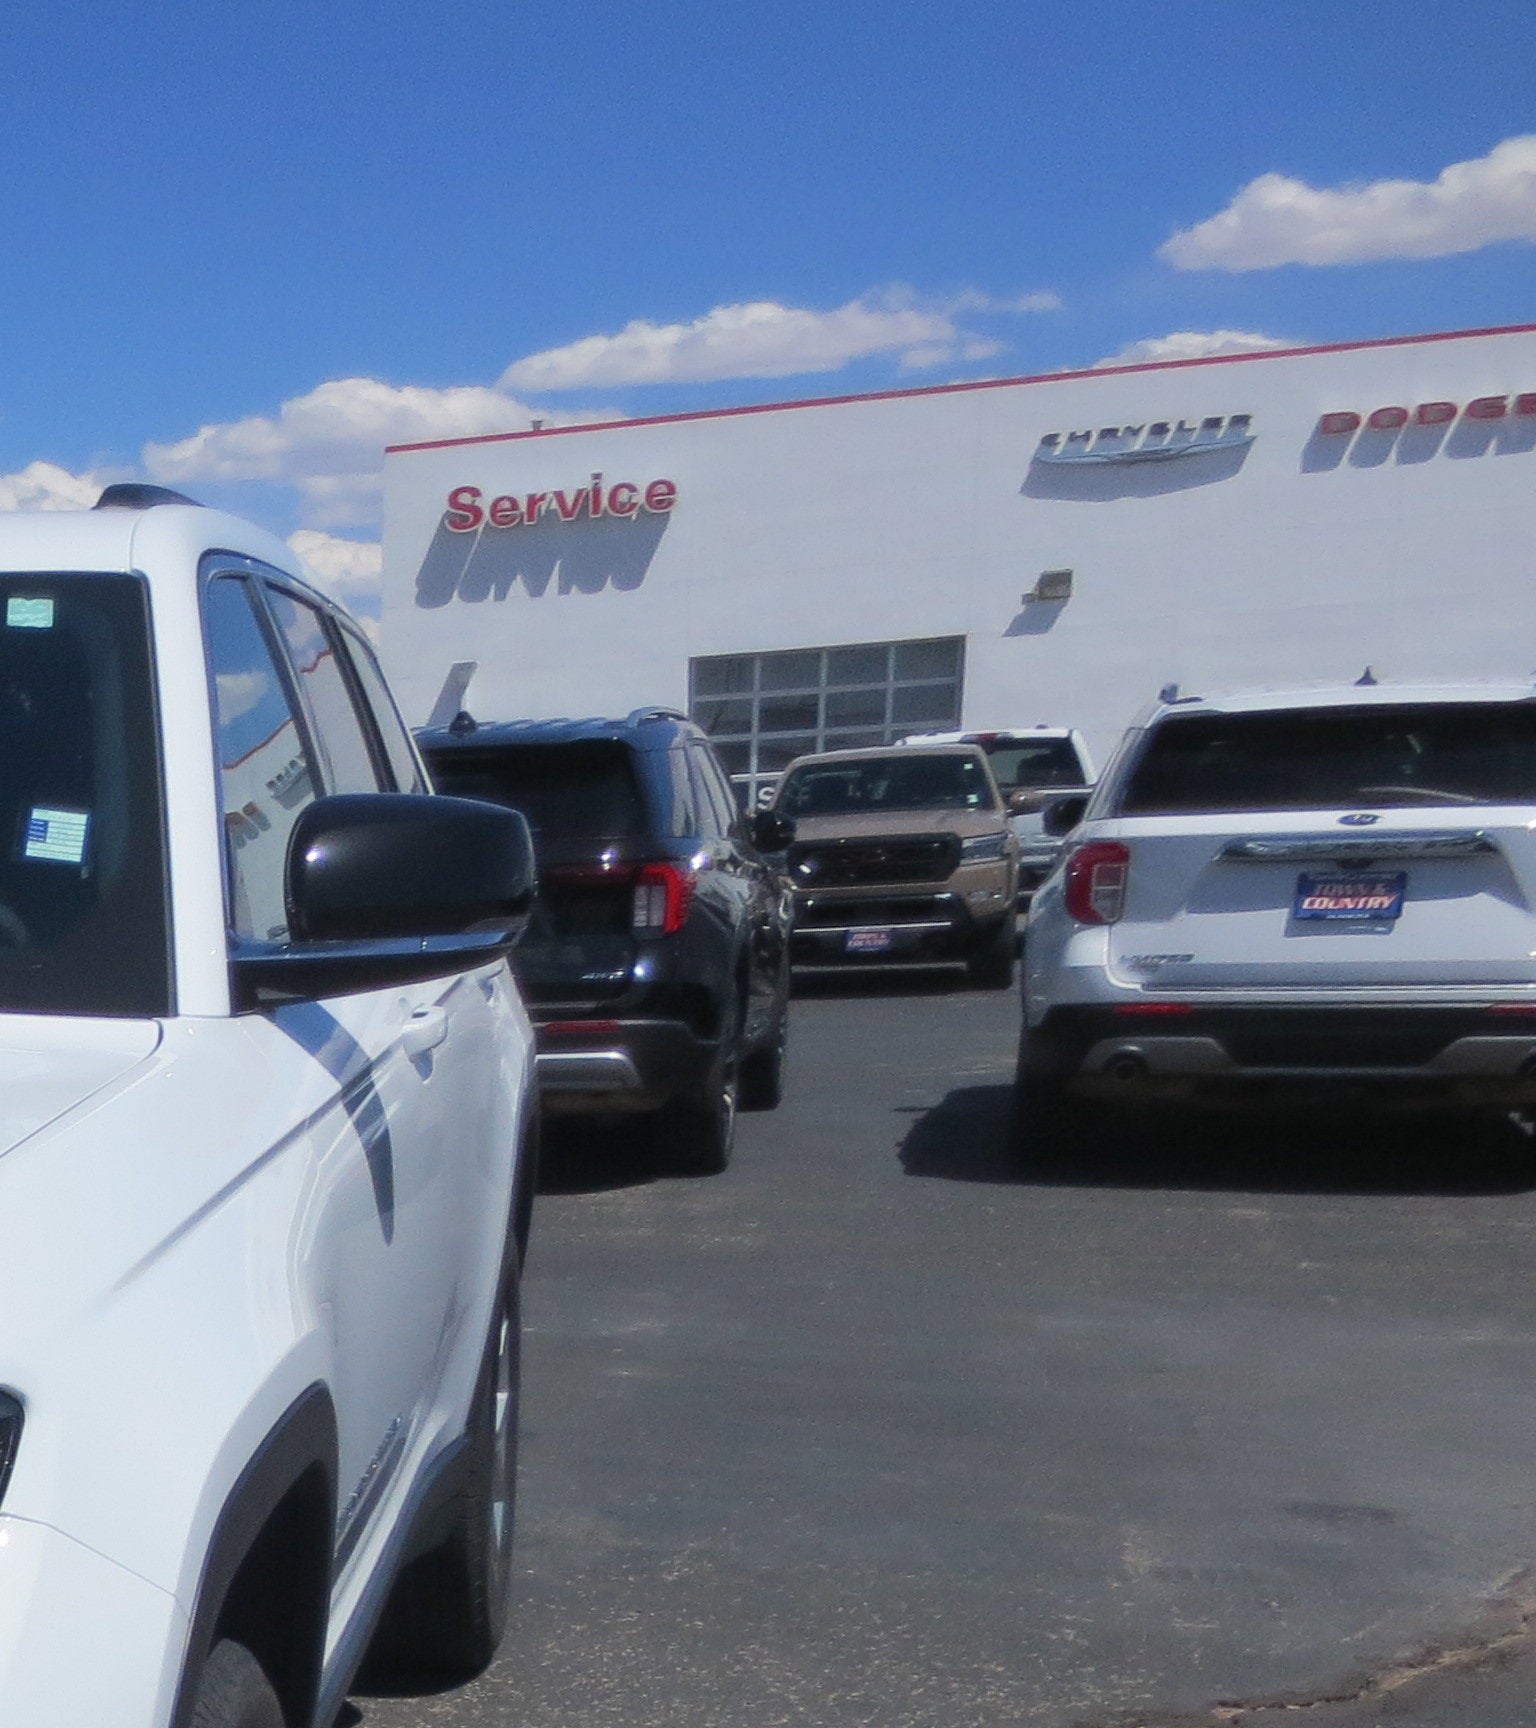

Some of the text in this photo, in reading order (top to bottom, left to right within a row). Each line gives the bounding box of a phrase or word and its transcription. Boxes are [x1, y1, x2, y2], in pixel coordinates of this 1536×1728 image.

[1040, 414, 1252, 446] CHRYSLER
[445, 472, 678, 533] Service
[1301, 895, 1398, 910] COUNTRY
